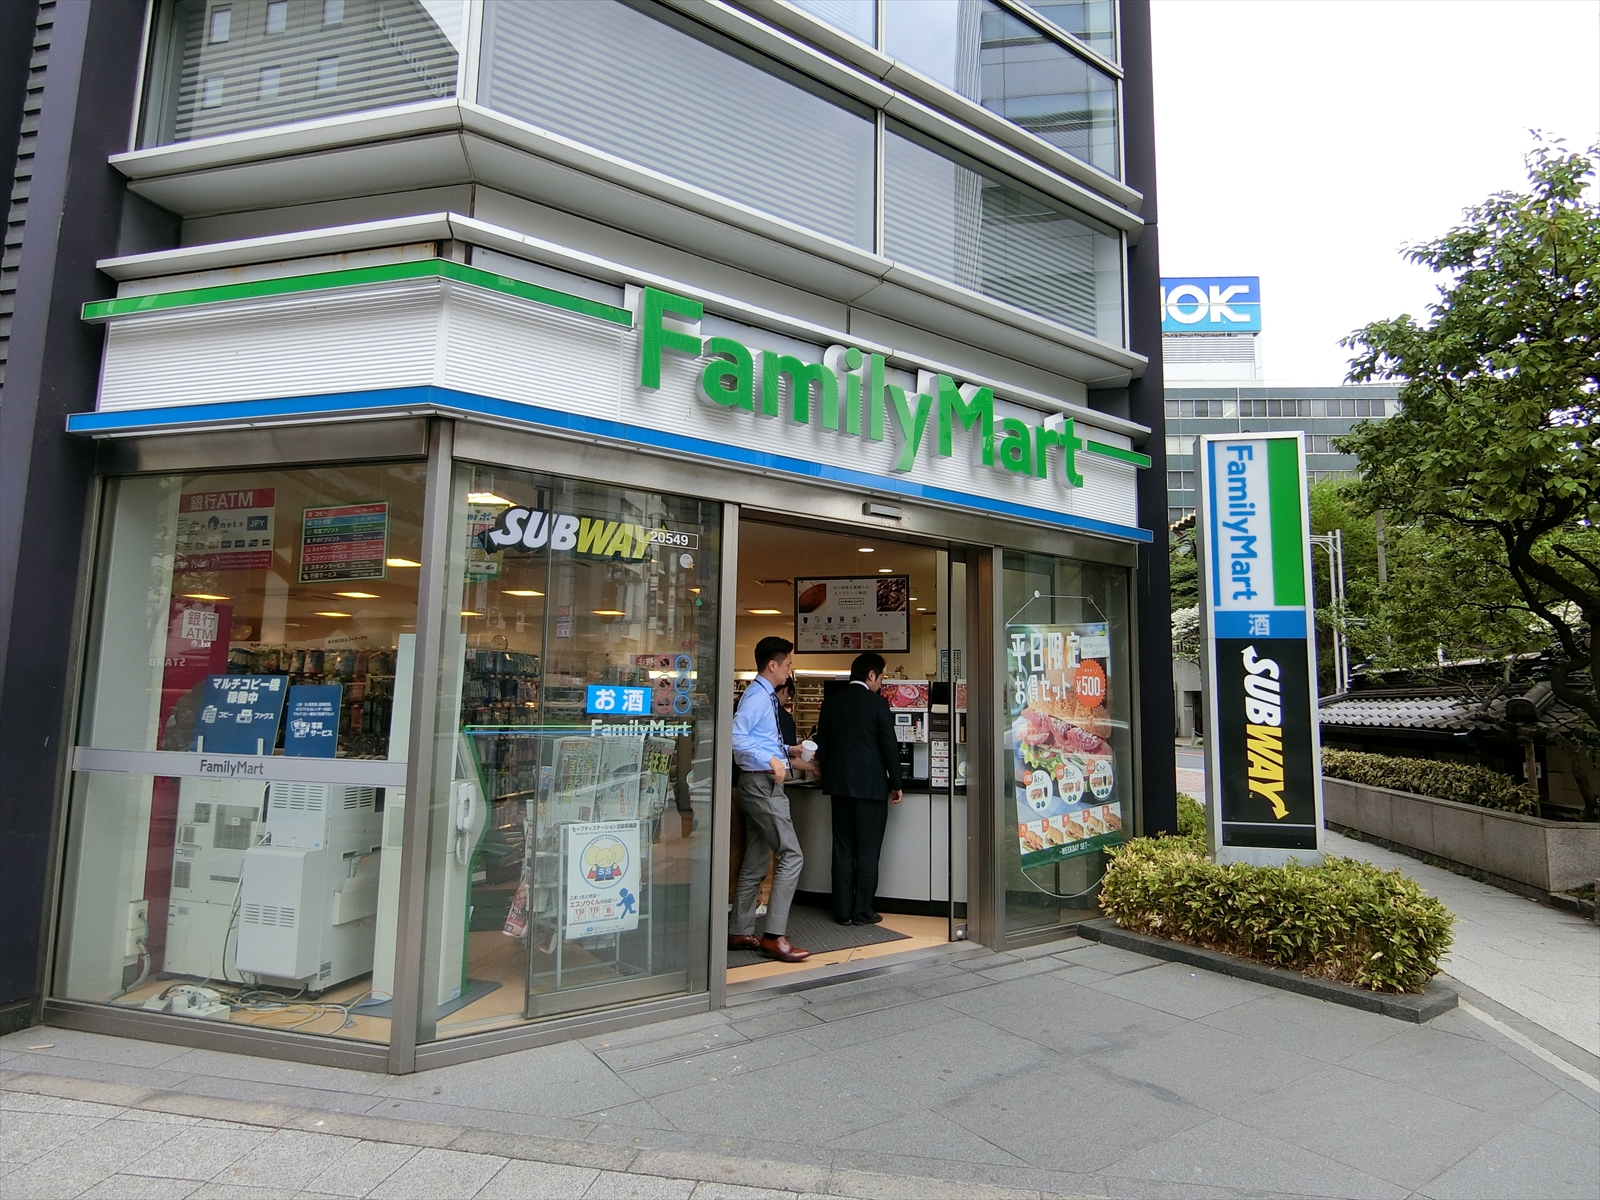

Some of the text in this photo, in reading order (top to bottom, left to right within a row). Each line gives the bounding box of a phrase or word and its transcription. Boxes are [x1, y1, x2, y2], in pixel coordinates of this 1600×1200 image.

[635, 285, 1084, 489] FamilyMart
[190, 491, 253, 511] 銀行ATM
[250, 519, 265, 528] JPY
[1222, 445, 1258, 601] FamilyMart
[489, 507, 667, 560] SUBWAY
[650, 531, 689, 546] 20549
[187, 611, 215, 628] 銀行
[1248, 614, 1270, 636] 酒
[186, 628, 213, 640] ATM
[1010, 632, 1081, 673] 平日限定
[213, 678, 281, 692] マルチコピー機
[1015, 672, 1071, 705] お得セット
[227, 691, 259, 705] 稼働中
[594, 688, 645, 712] お酒
[218, 711, 234, 719] コピー
[254, 712, 275, 720] ファクス
[310, 729, 333, 737] サービス
[311, 721, 323, 729] 写真
[590, 719, 688, 743] FamilyMart
[1240, 645, 1290, 820] SUBWAY
[200, 759, 264, 777] FamilyMart
[598, 868, 612, 876] SS
[590, 906, 600, 914] 119
